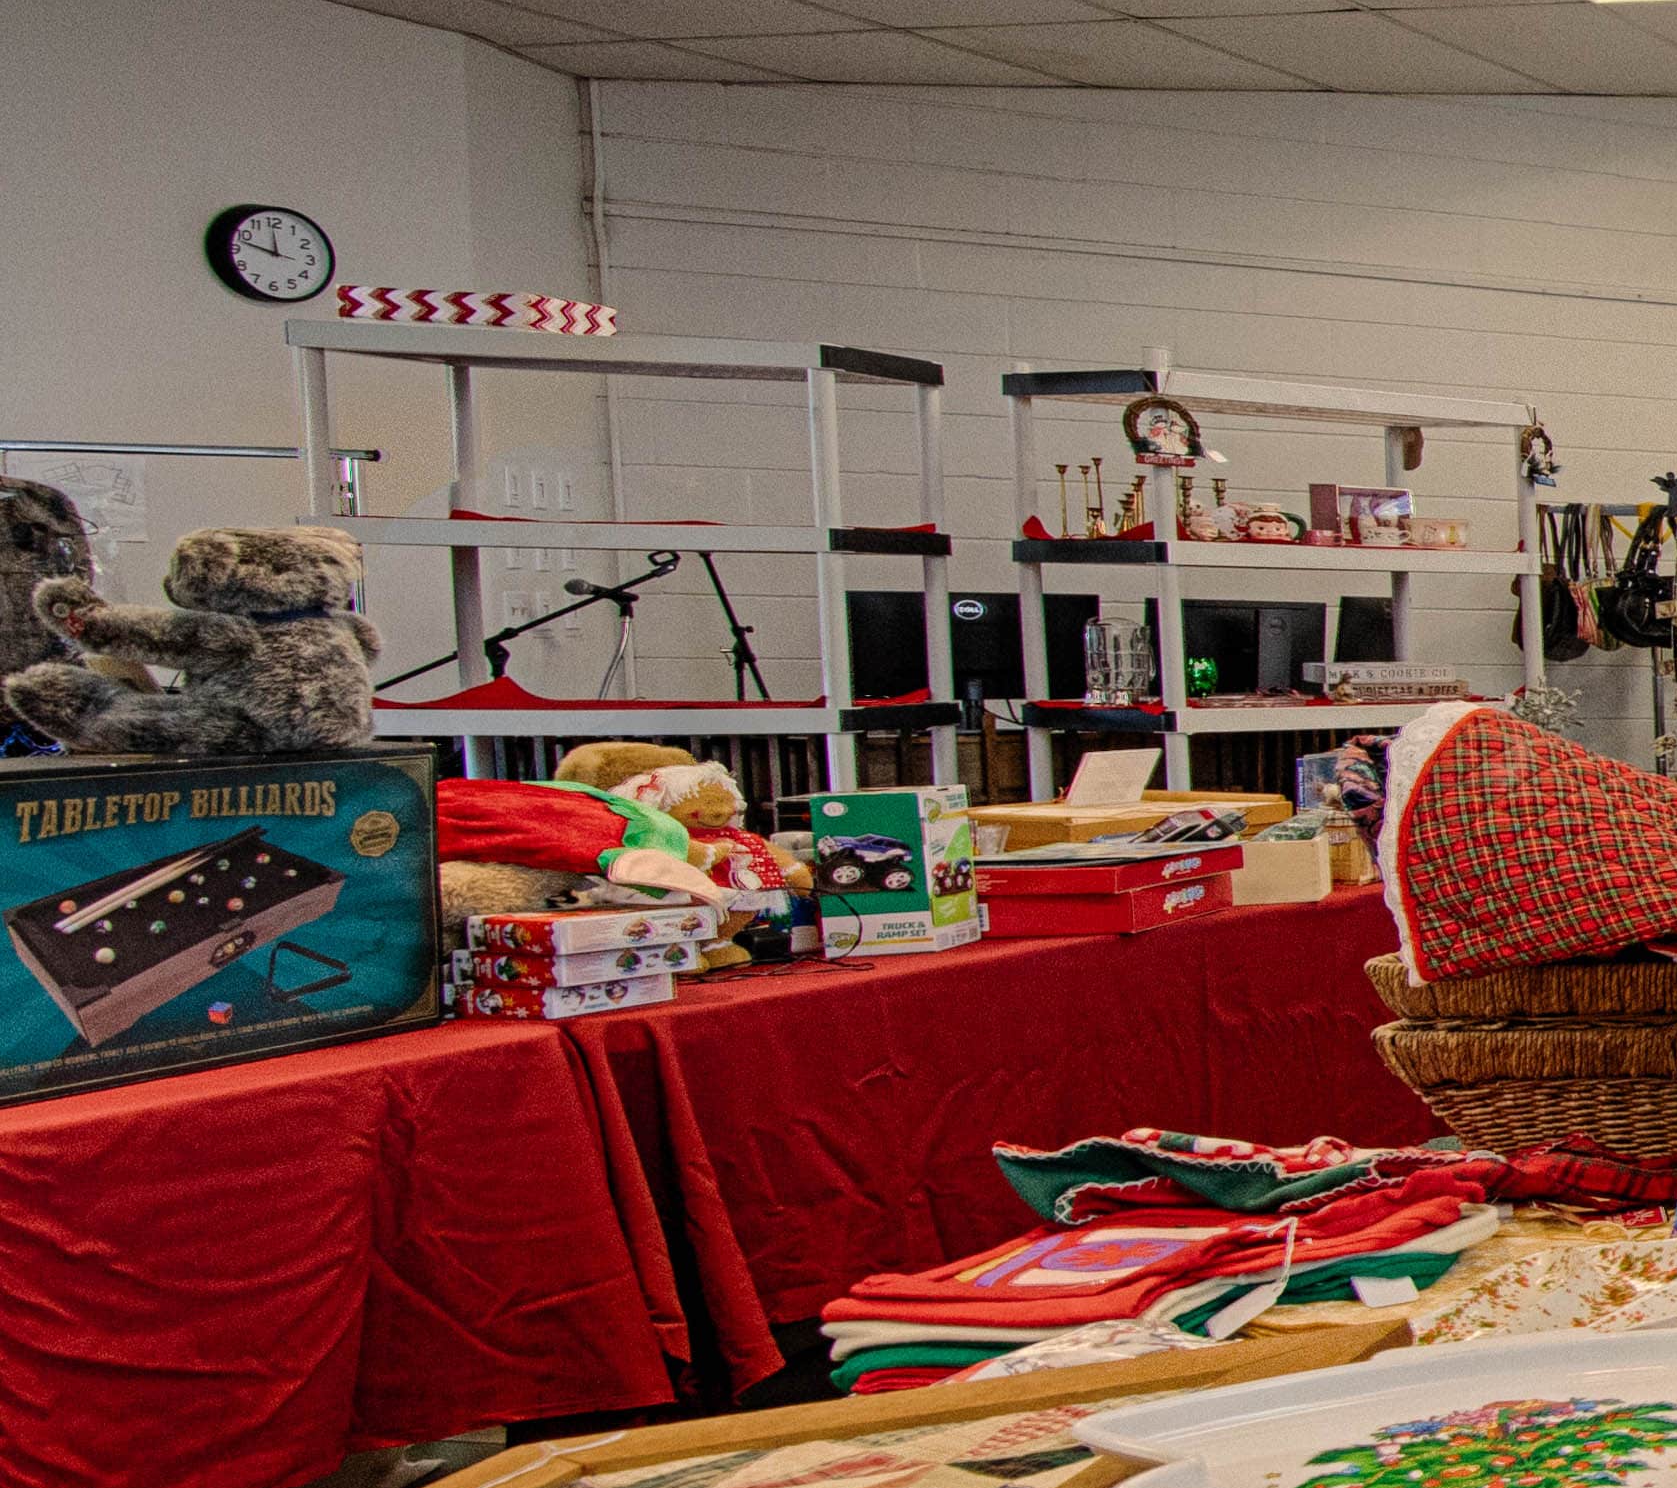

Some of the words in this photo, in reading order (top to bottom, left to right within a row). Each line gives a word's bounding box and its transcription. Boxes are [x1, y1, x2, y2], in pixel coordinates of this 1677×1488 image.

[250, 218, 261, 231] 11
[265, 216, 282, 230] 12
[237, 229, 252, 241] 10
[290, 225, 296, 236] 1
[231, 243, 241, 255] 9
[299, 238, 311, 251] 2
[237, 259, 248, 272] 8
[304, 254, 316, 266] 3
[249, 273, 261, 284] 7
[298, 270, 309, 280] 4
[268, 281, 279, 292] 6
[287, 278, 298, 290] 5
[1380, 668, 1426, 679] COOKIE
[1428, 684, 1458, 695] TREES
[16, 791, 181, 843] TABLETOP
[190, 780, 337, 819] BILLIARDS
[882, 921, 915, 930] TRUCK
[876, 930, 908, 939] RAMP
[910, 929, 927, 937] SET
